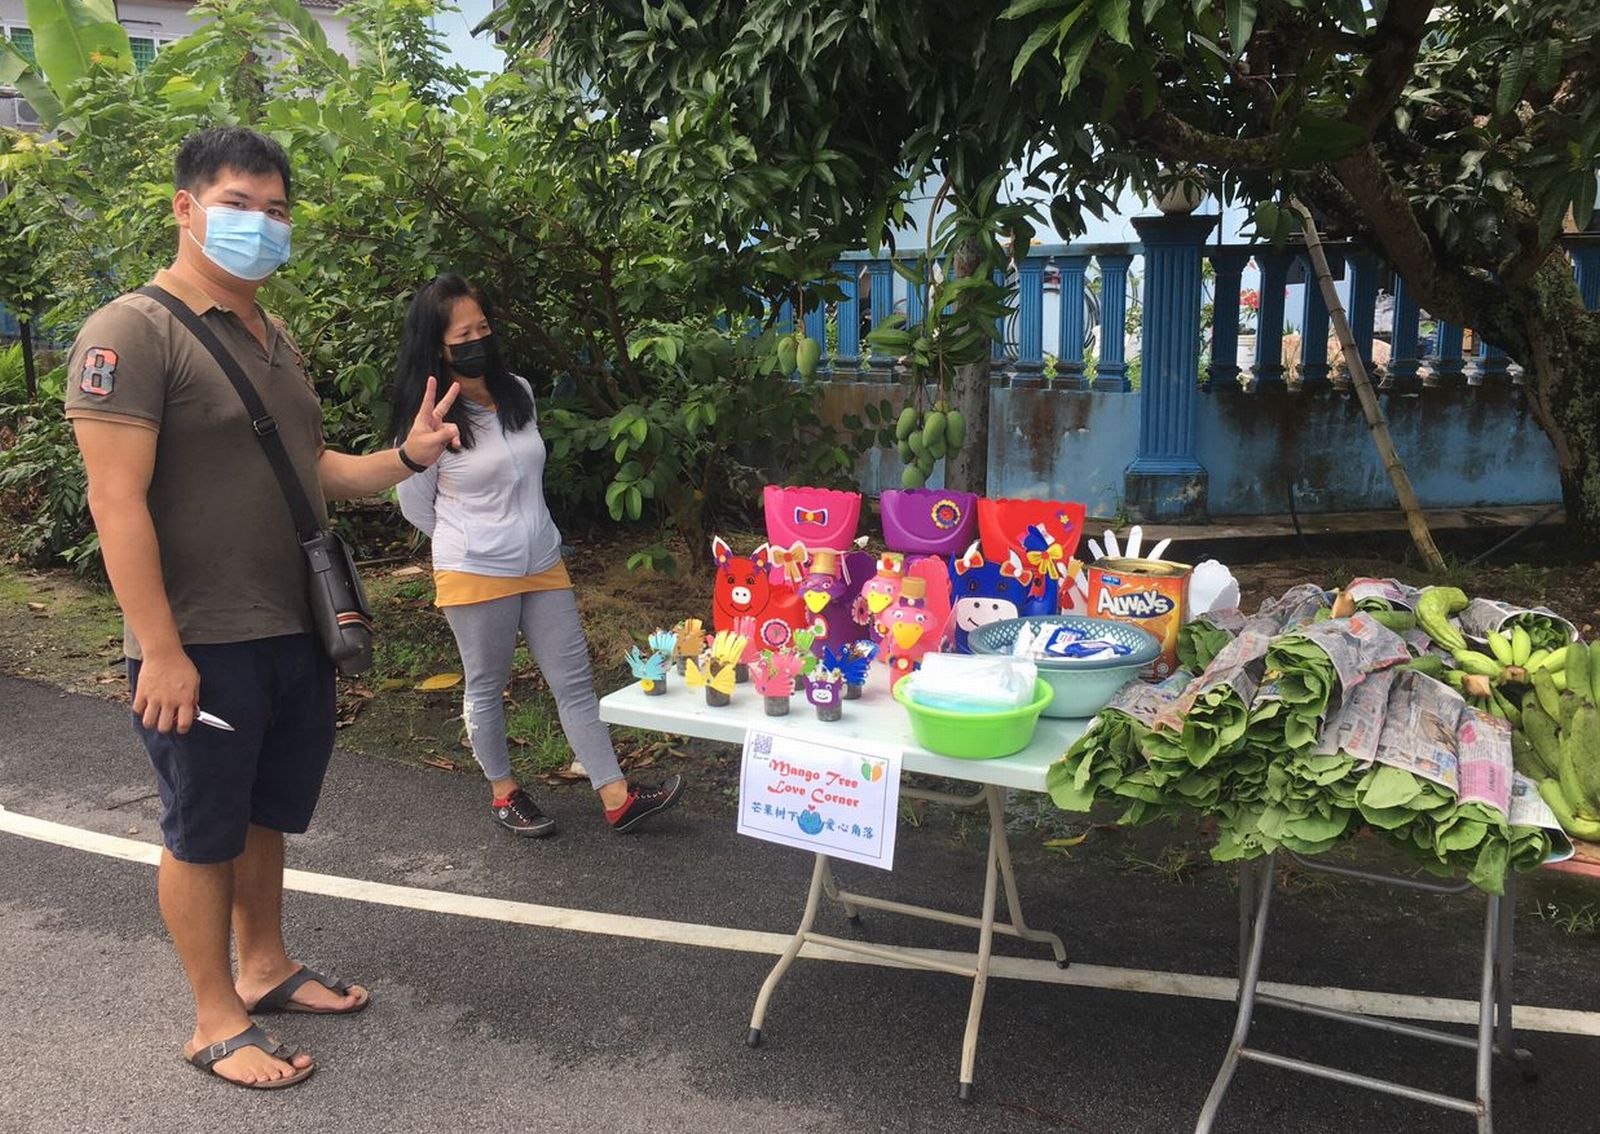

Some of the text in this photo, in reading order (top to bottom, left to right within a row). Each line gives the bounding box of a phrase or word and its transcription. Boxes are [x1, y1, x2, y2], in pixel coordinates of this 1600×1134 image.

[80, 347, 118, 396] 8
[1097, 587, 1169, 616] ALWAYS
[769, 759, 859, 789] Mango Tree
[767, 780, 860, 807] Love Corner
